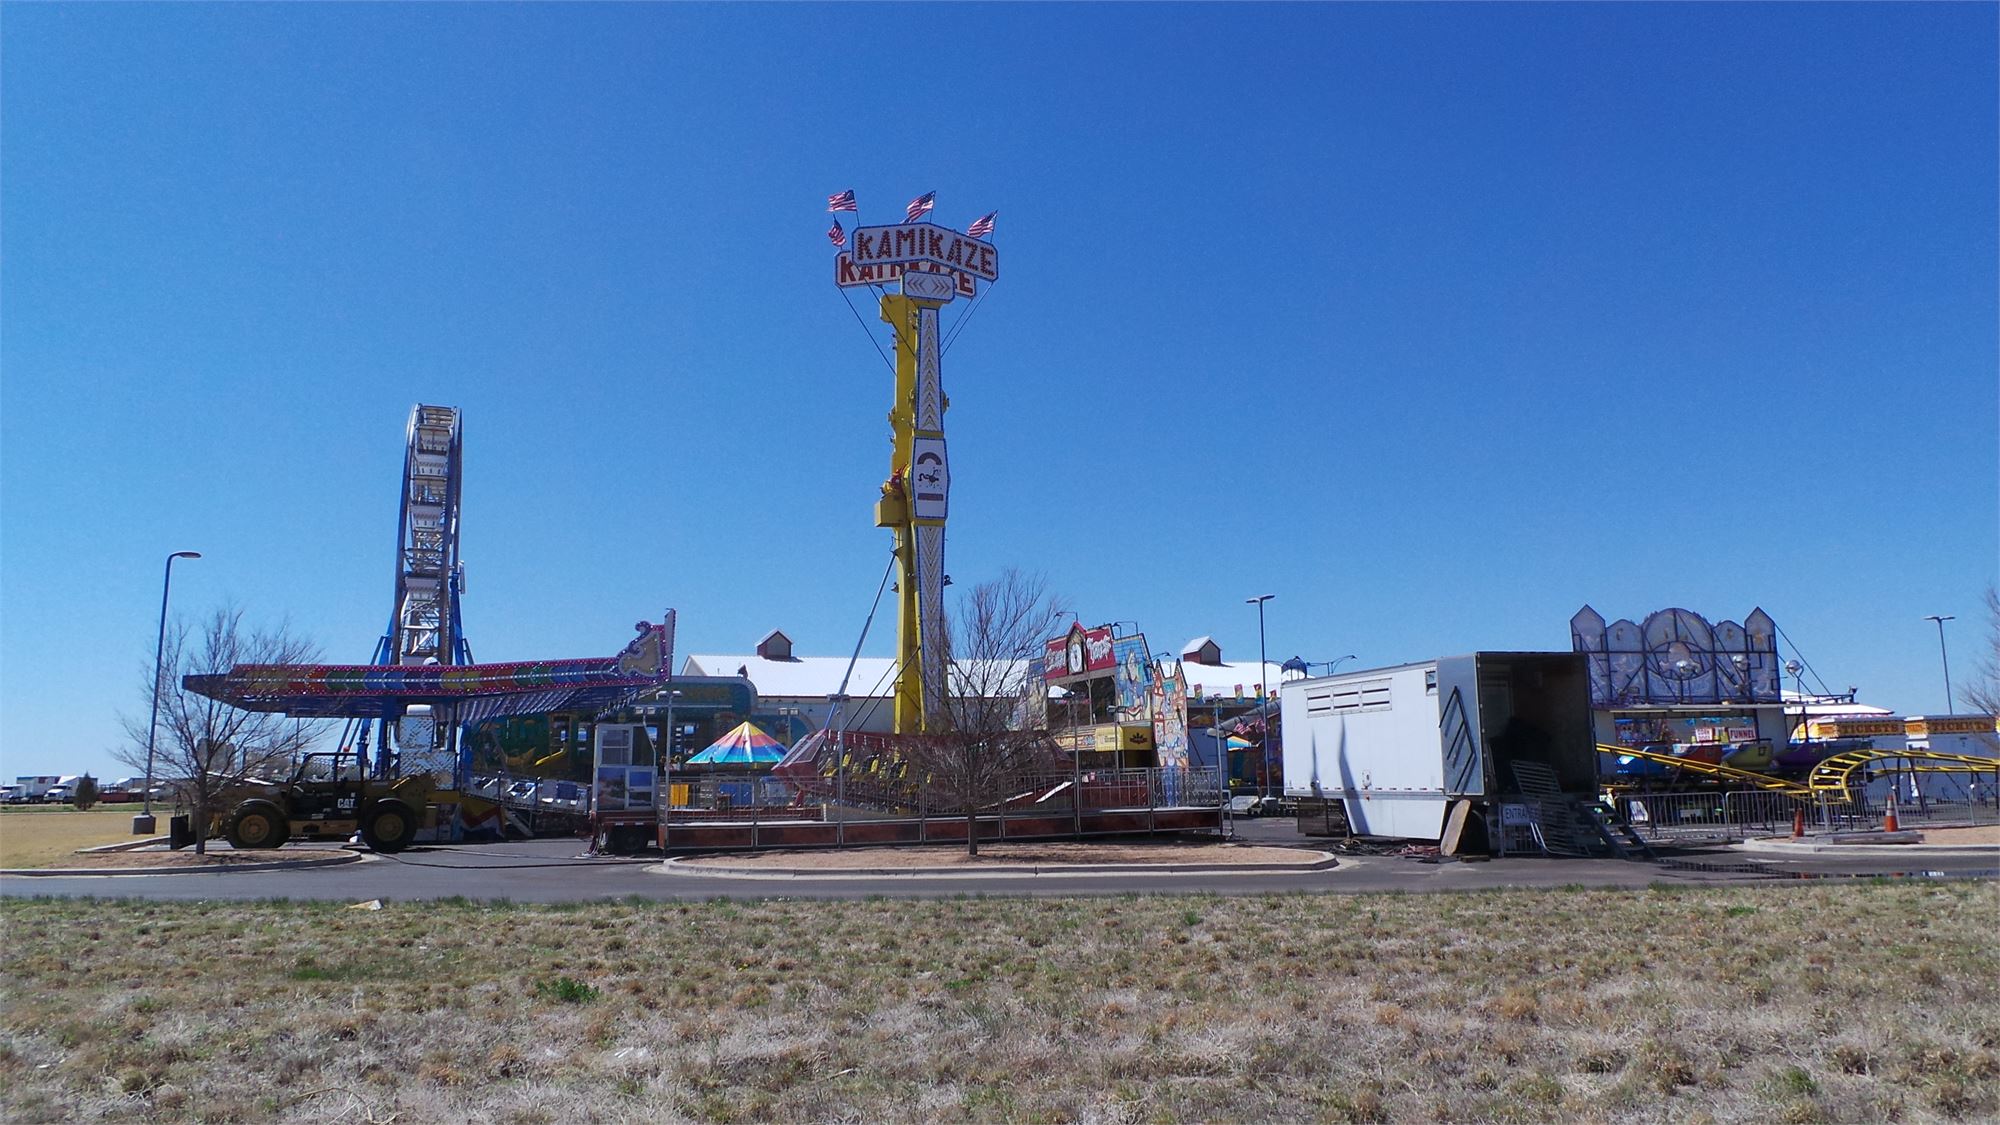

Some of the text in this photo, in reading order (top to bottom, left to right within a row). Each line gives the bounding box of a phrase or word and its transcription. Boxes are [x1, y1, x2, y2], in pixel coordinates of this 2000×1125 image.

[857, 228, 995, 276] KAMIKAZE
[1730, 728, 1755, 739] FUNNEL
[1842, 723, 1899, 734] TICKETS
[337, 798, 355, 809] CAT
[1506, 807, 1538, 819] ENTRA
